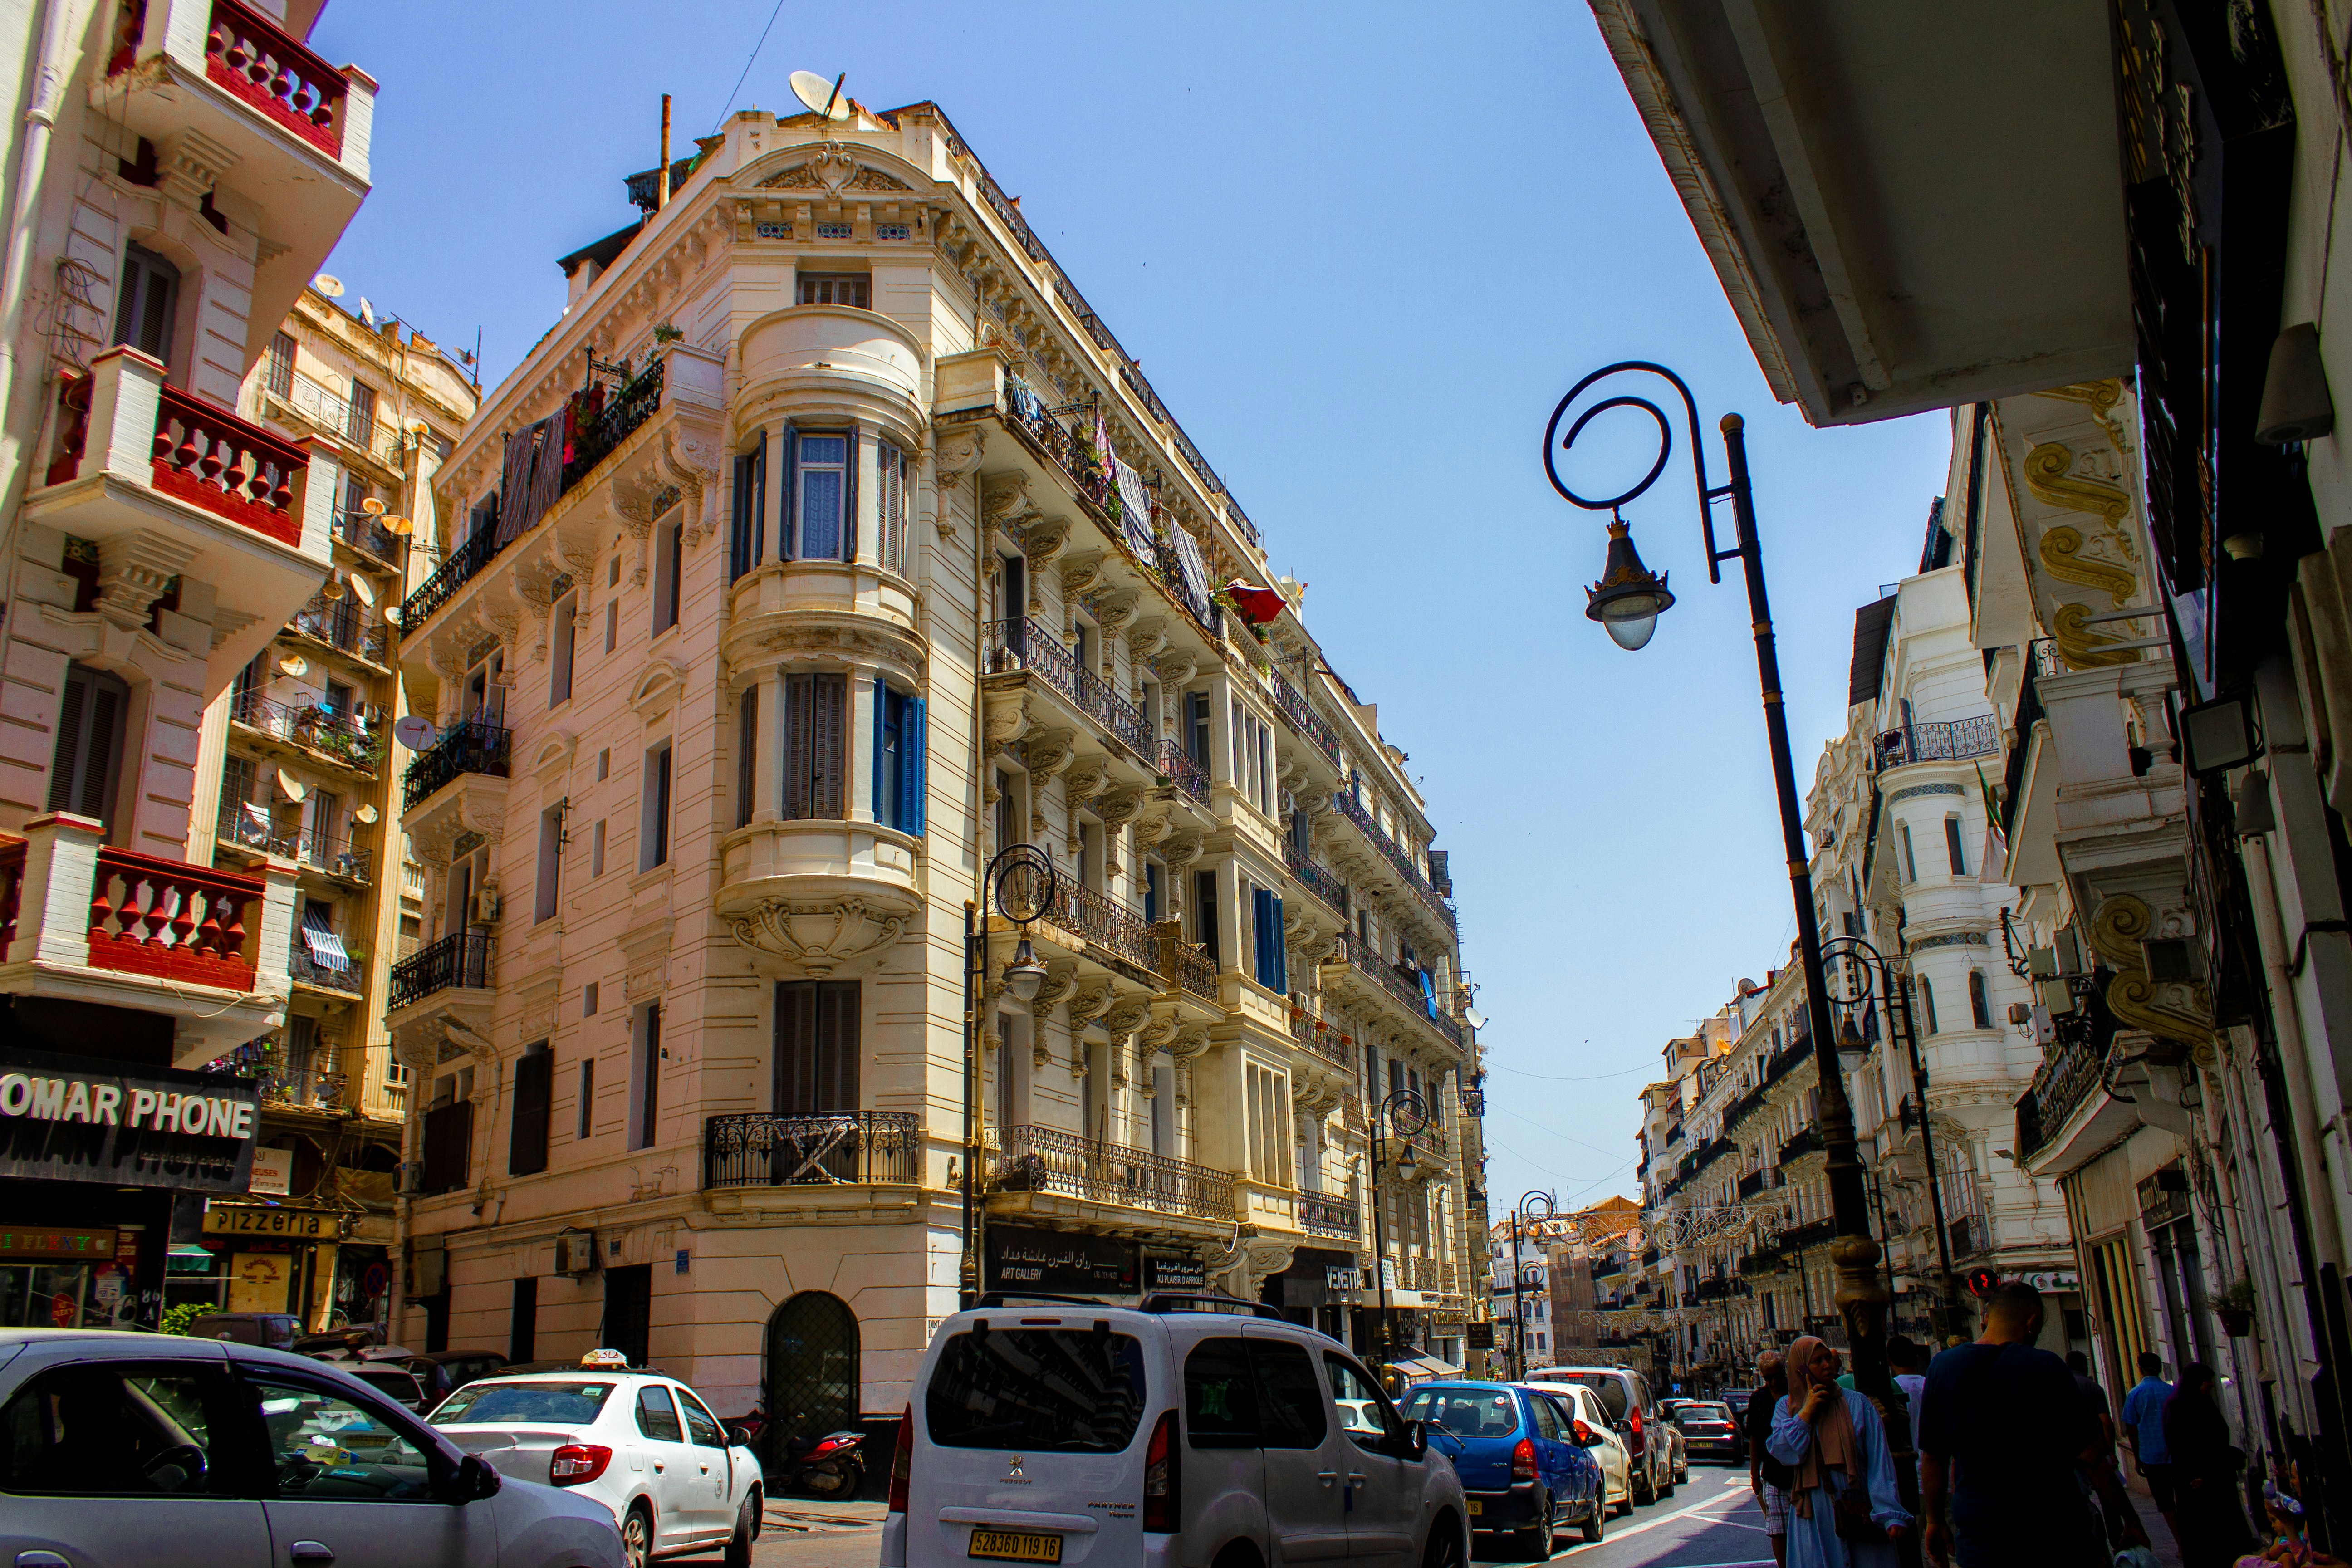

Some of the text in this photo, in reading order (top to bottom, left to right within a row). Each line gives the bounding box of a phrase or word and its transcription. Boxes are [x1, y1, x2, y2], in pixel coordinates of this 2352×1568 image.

[0, 1073, 255, 1139] OMAR PHONE
[218, 1212, 320, 1234] pizzeria
[23, 1234, 90, 1251] FLEXY
[1022, 1247, 1047, 1263] عائشة
[1048, 1250, 1074, 1268] الفنون
[1075, 1251, 1092, 1269] رواق
[1001, 1267, 1042, 1281] ART GALLERY
[1157, 1274, 1203, 1285] AU PLAISIR D'AFRIQUE
[1088, 1501, 1136, 1509] PARTNER
[1470, 1503, 1479, 1513] 16
[975, 1533, 1057, 1557] 528360 119 16
